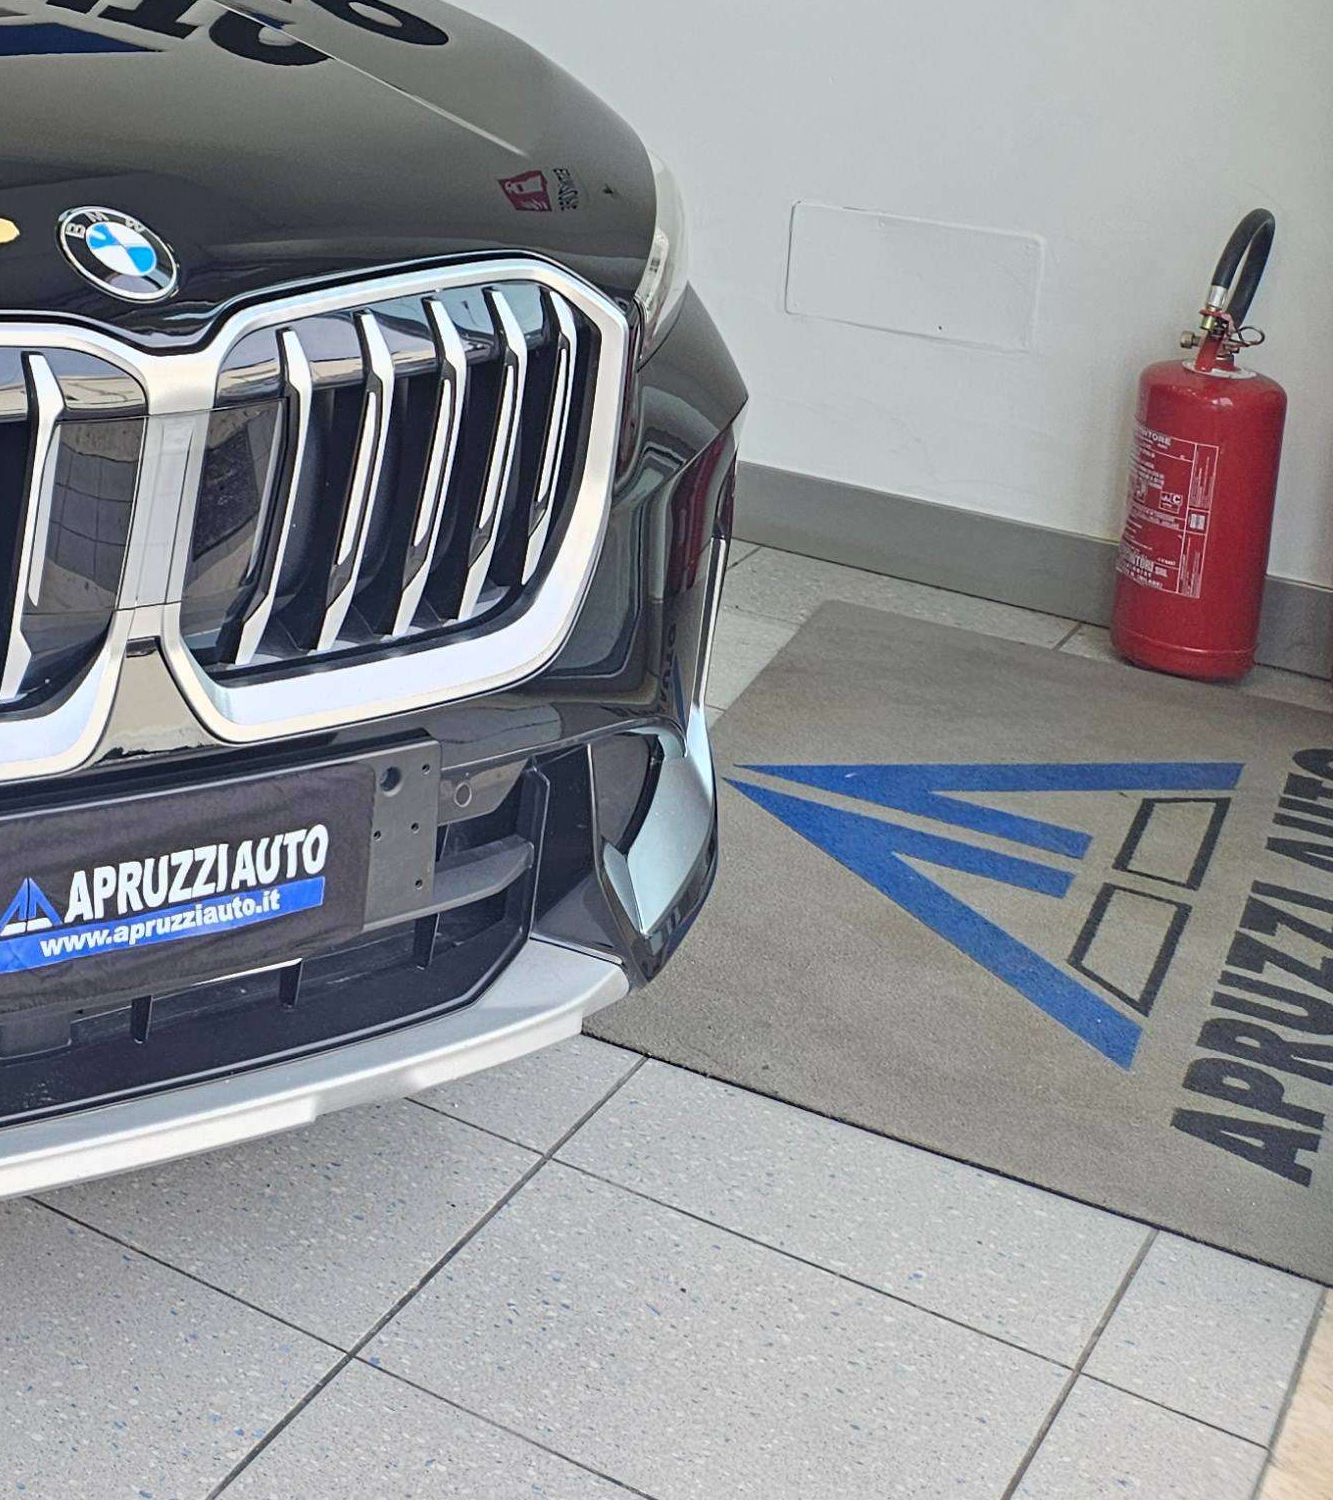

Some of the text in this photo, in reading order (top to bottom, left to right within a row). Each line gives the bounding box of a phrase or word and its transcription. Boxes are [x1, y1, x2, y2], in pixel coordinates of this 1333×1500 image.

[65, 211, 147, 239] BMW
[64, 823, 329, 924] APRUZZI AUTO
[39, 888, 281, 957] www.apruzziauto.it
[1169, 879, 1333, 1188] APRUZZI
